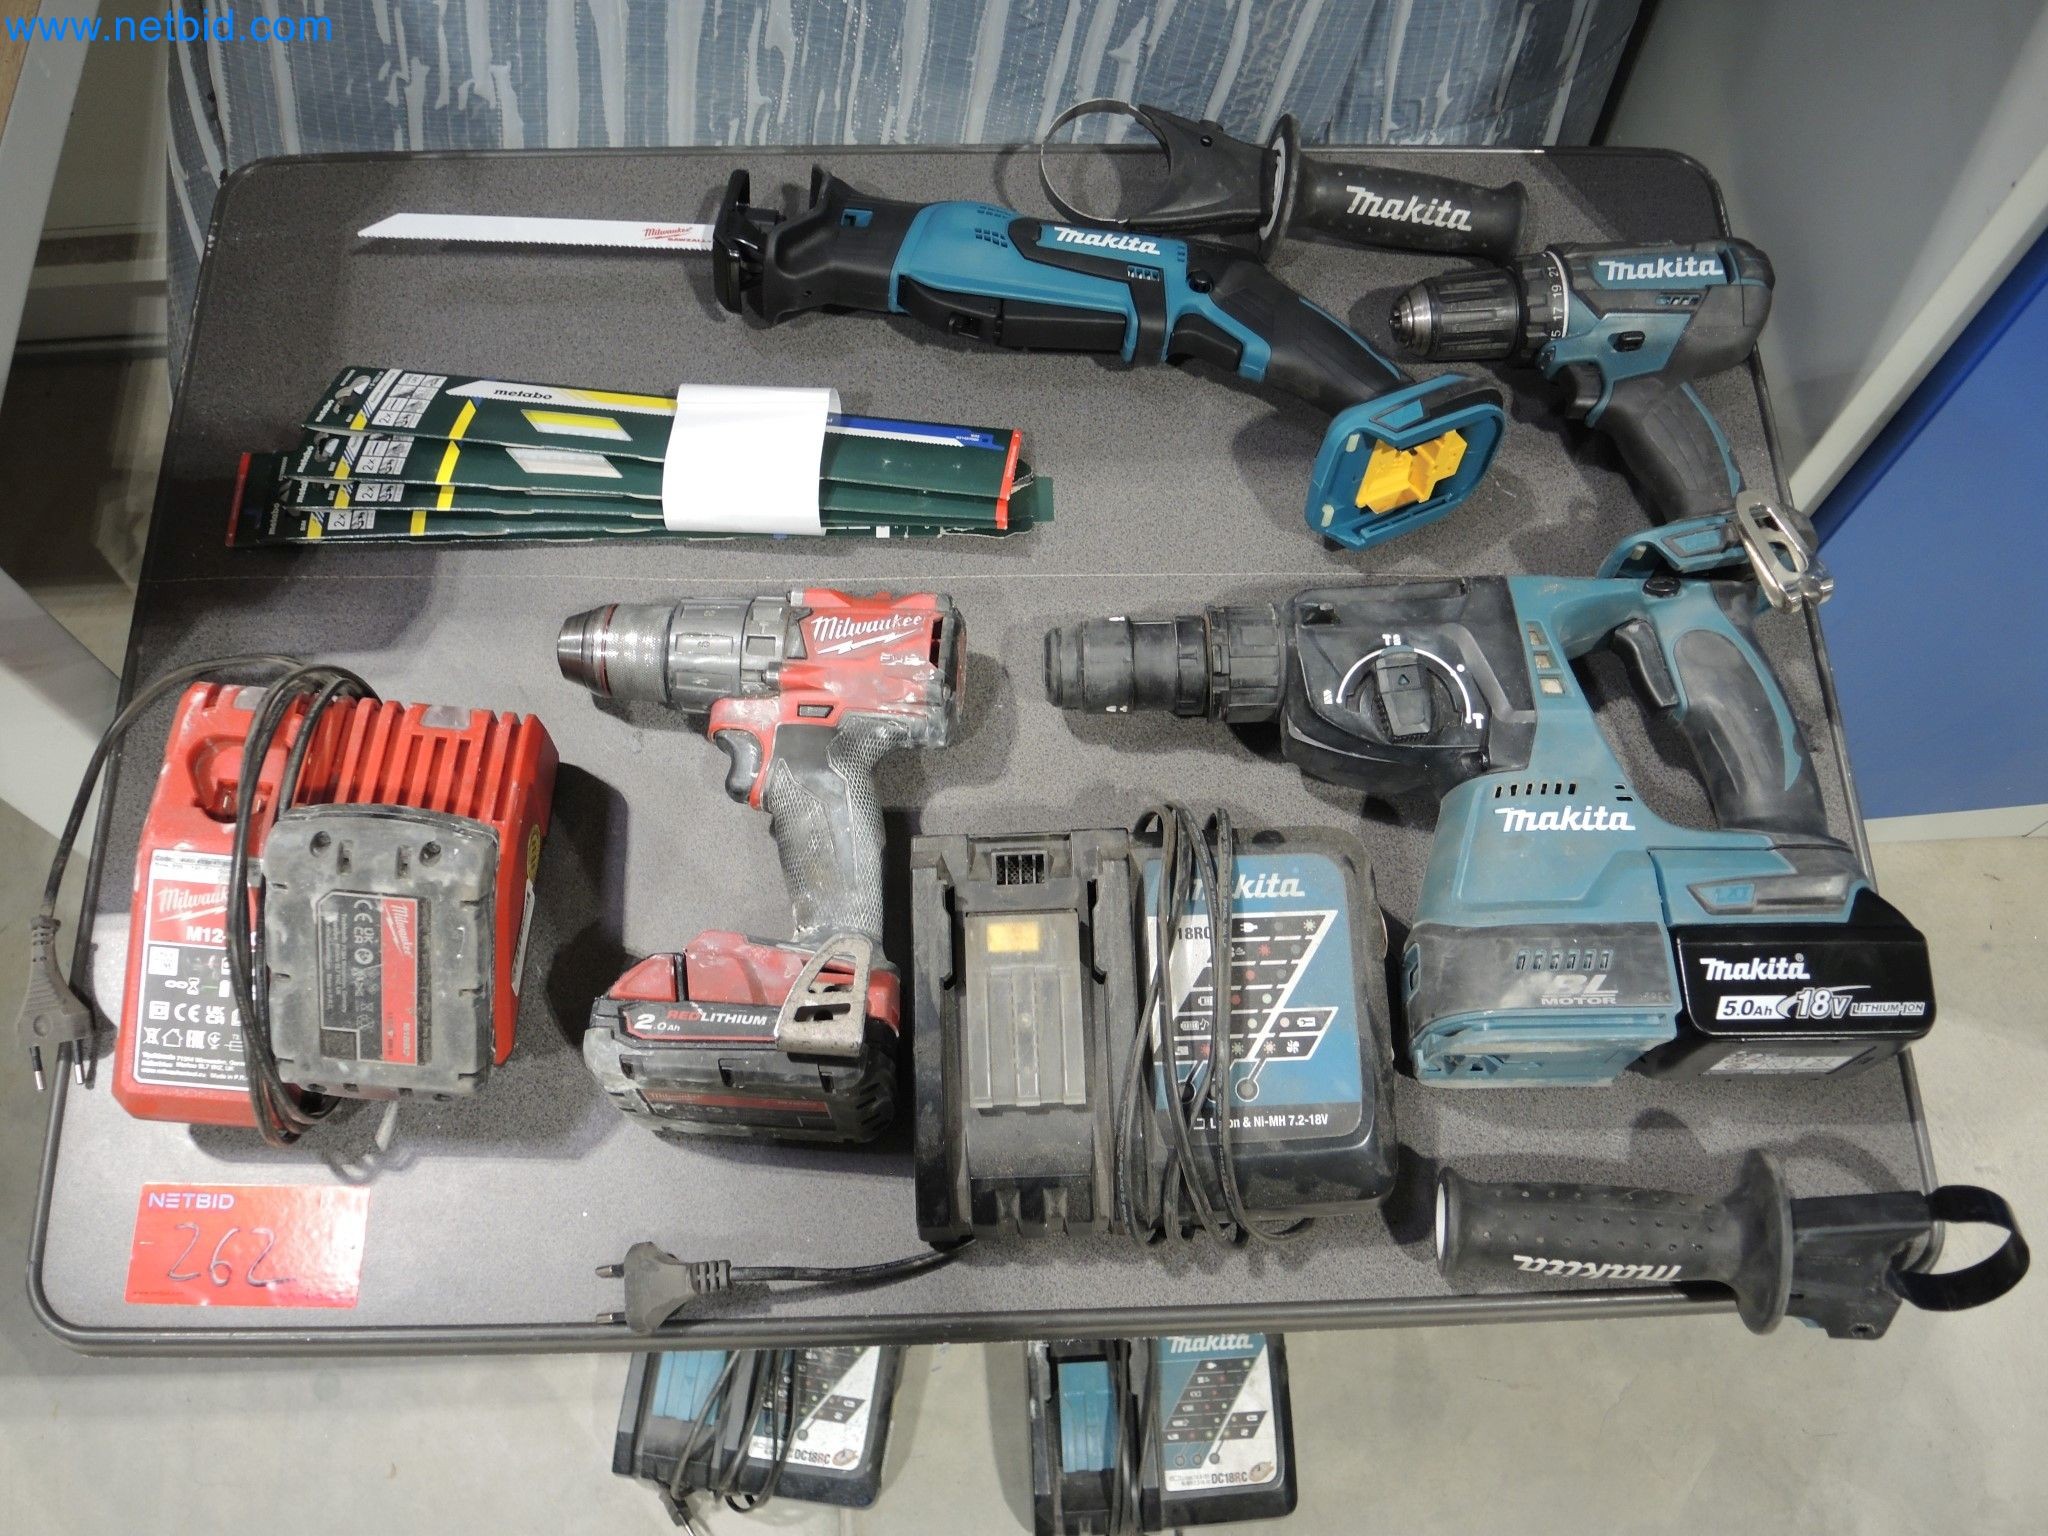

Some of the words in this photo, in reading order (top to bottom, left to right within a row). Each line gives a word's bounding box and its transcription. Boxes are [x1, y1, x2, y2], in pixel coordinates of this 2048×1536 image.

[1345, 185, 1472, 232] makita
[1053, 226, 1161, 256] makita
[1598, 255, 1724, 281] makita
[1551, 284, 1563, 298] 19
[1552, 307, 1563, 321] 17
[494, 388, 553, 400] metabo
[811, 614, 924, 643] Milwaukee
[1495, 806, 1637, 833] makita
[155, 886, 228, 912] Milwauk
[1699, 956, 1811, 981] makita
[1540, 996, 1617, 1006] MOTOR
[1722, 999, 1774, 1017] 5.0Ah
[1796, 987, 1853, 1019] 18V
[1851, 1001, 1926, 1017] LITHIUM-ION
[1242, 1116, 1252, 1128] &
[1253, 1115, 1286, 1128] Ni-MH
[1288, 1113, 1329, 1127] 7.2-18V
[148, 1192, 235, 1210] NETBID
[167, 1221, 297, 1287] 262
[794, 1448, 831, 1465] DC18RC
[1211, 1471, 1248, 1484] DC18RC
